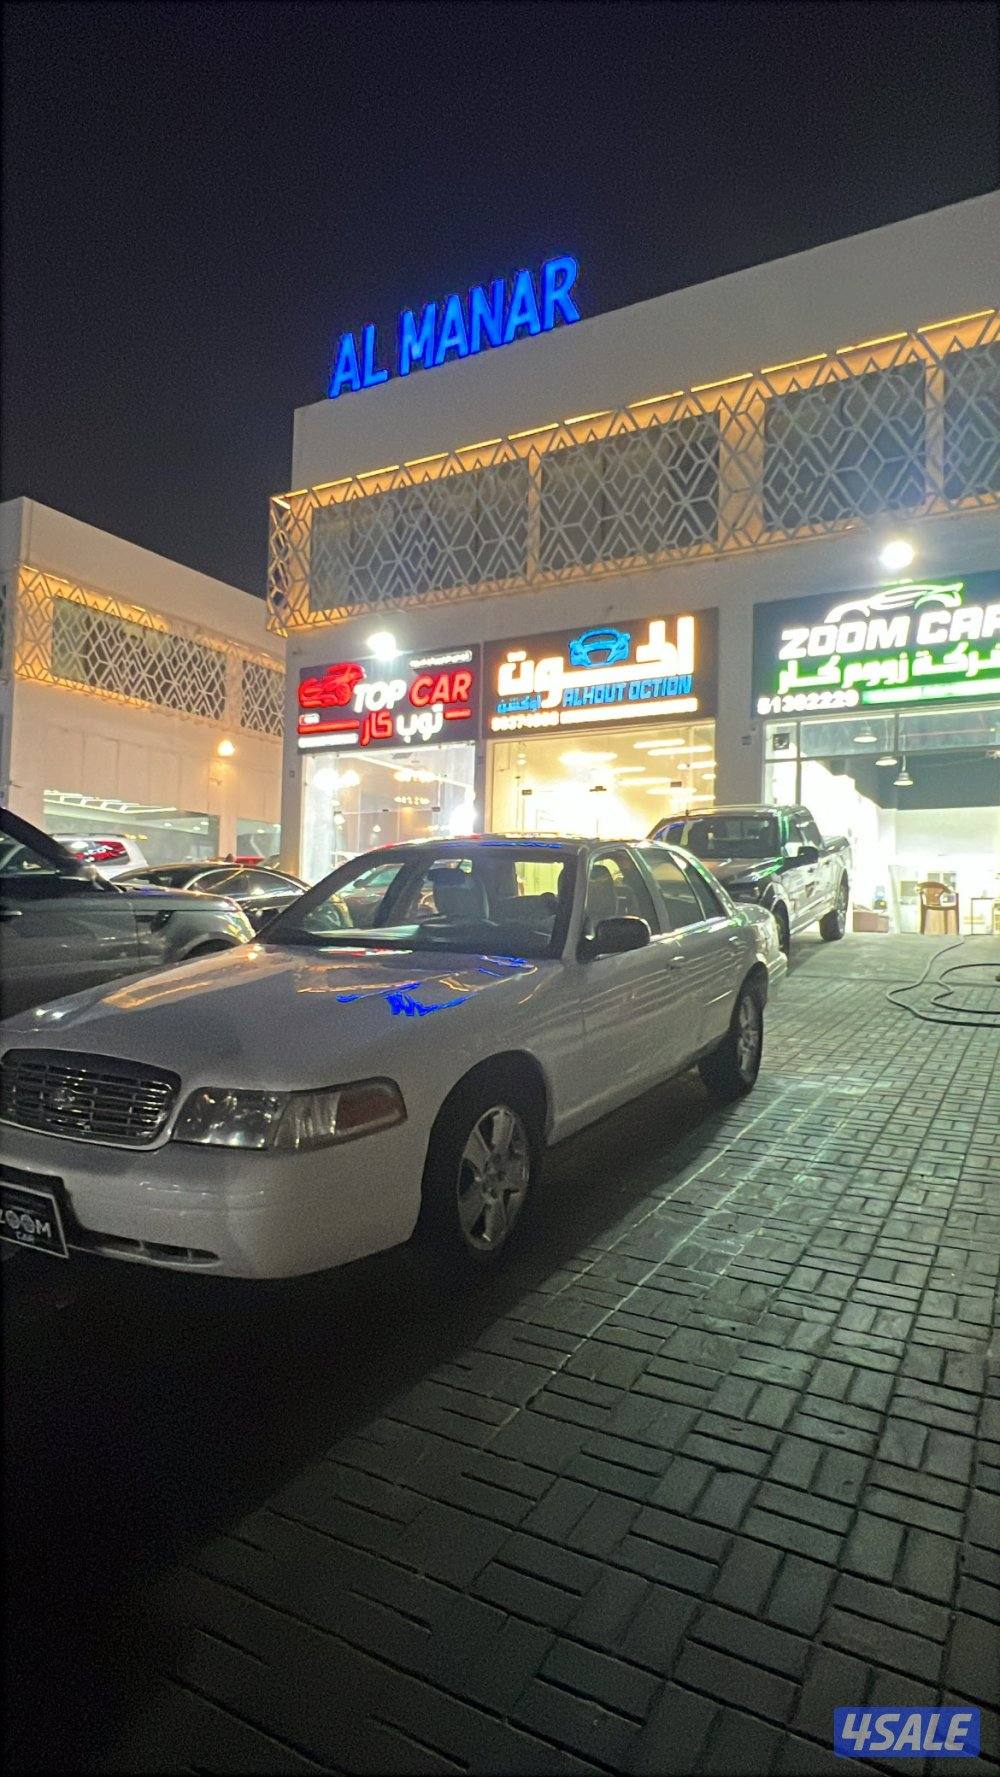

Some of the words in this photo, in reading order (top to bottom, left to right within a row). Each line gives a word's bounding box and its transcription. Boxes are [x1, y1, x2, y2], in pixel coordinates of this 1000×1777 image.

[328, 323, 389, 399] AL
[399, 255, 581, 378] MANAR
[778, 615, 911, 660] ZOOM
[353, 679, 407, 713] TOP
[409, 668, 473, 707] CAR
[562, 682, 627, 707] ALHOUT
[628, 674, 693, 701] OCTION
[359, 711, 394, 746] كار
[396, 703, 444, 743] توب
